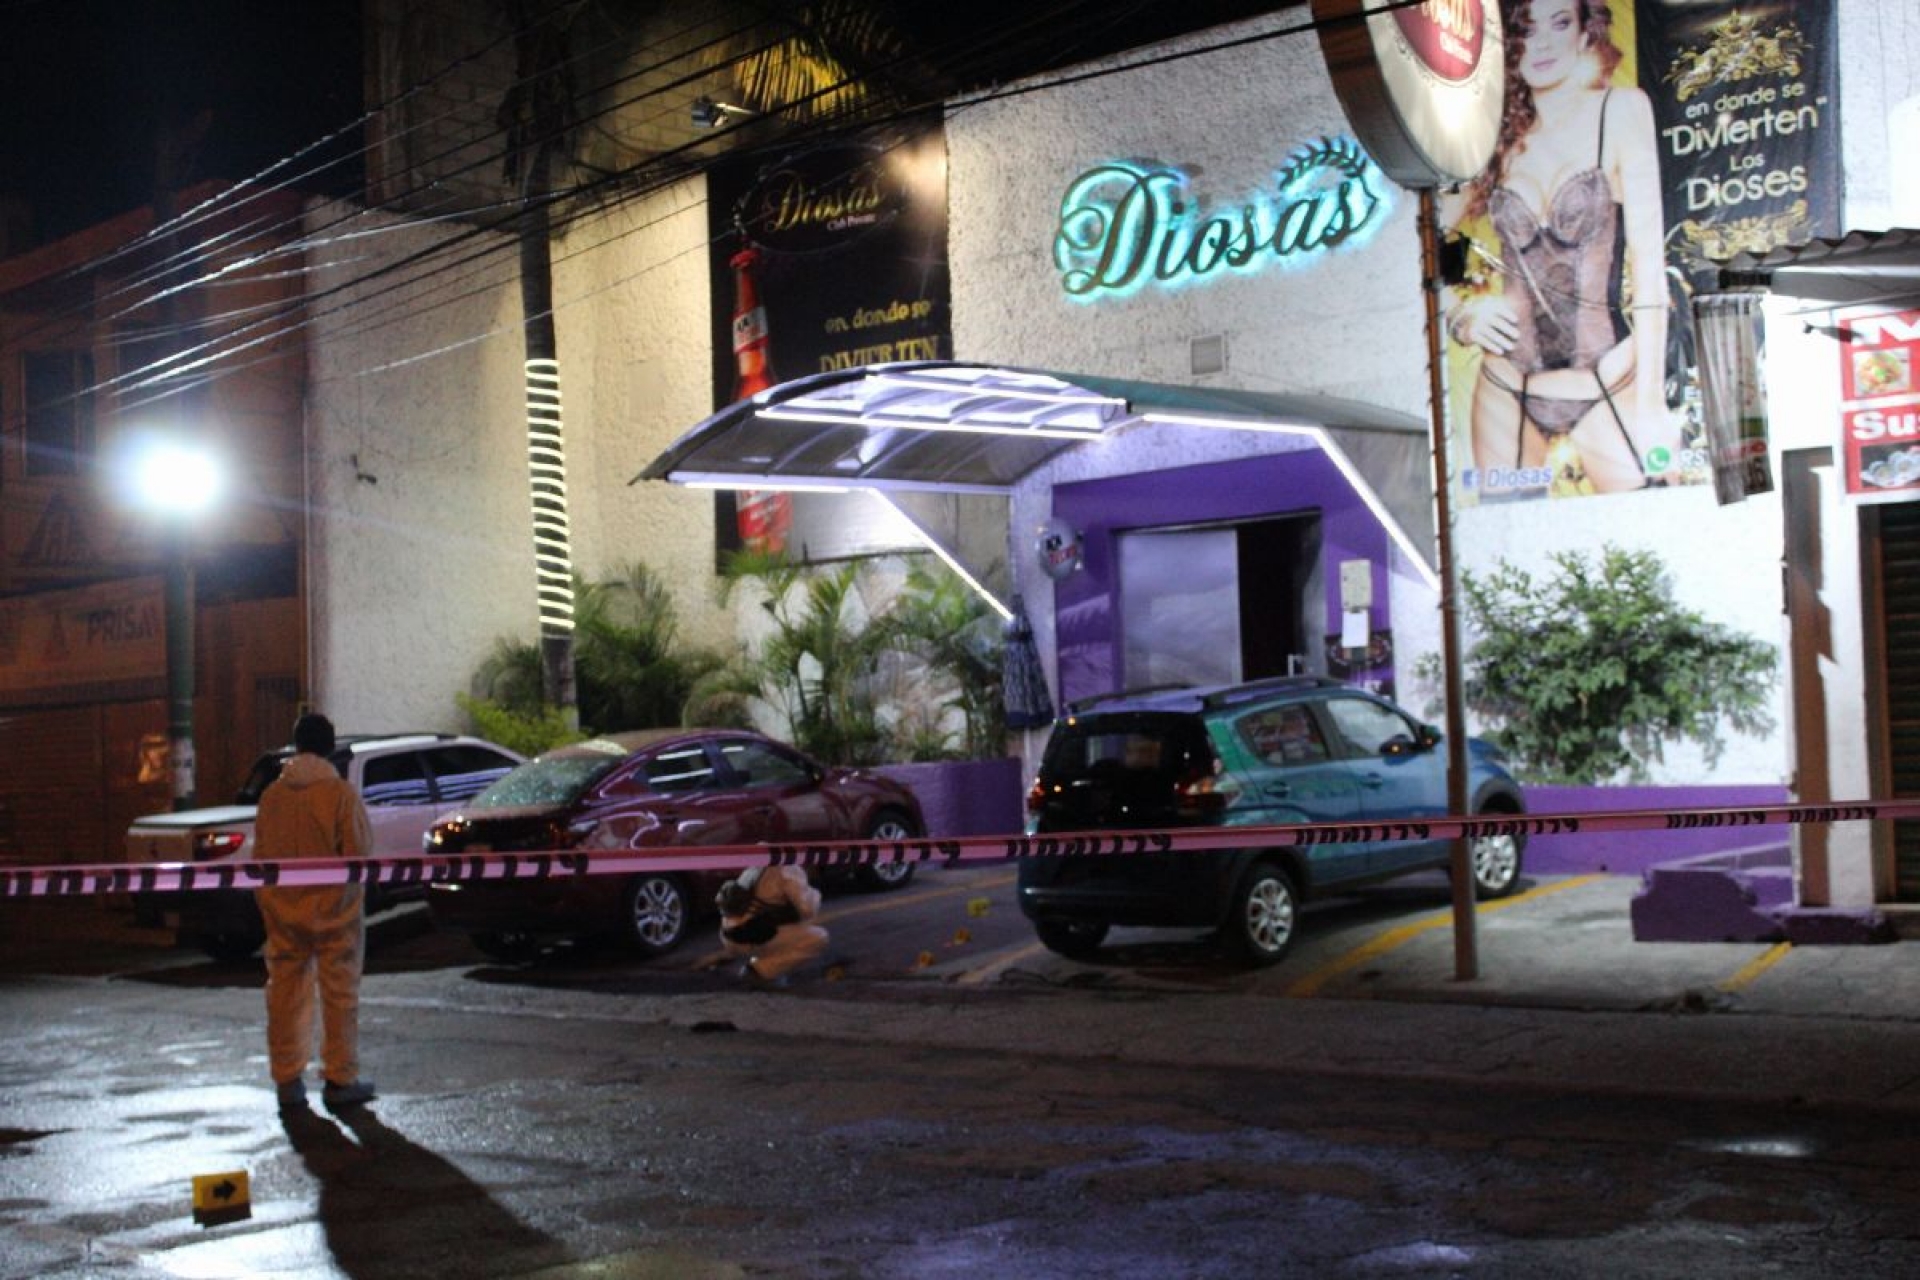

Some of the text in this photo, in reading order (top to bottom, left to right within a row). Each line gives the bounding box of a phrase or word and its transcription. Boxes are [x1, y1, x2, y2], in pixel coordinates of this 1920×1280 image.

[1685, 81, 1806, 119] en donde se
[1730, 153, 1766, 171] Los
[764, 170, 884, 232] Diosas
[1686, 164, 1809, 212] Dioses
[1053, 160, 1379, 295] Diosas
[852, 302, 910, 329] donde
[1852, 408, 1920, 441] Su
[1487, 466, 1553, 488] Diosas
